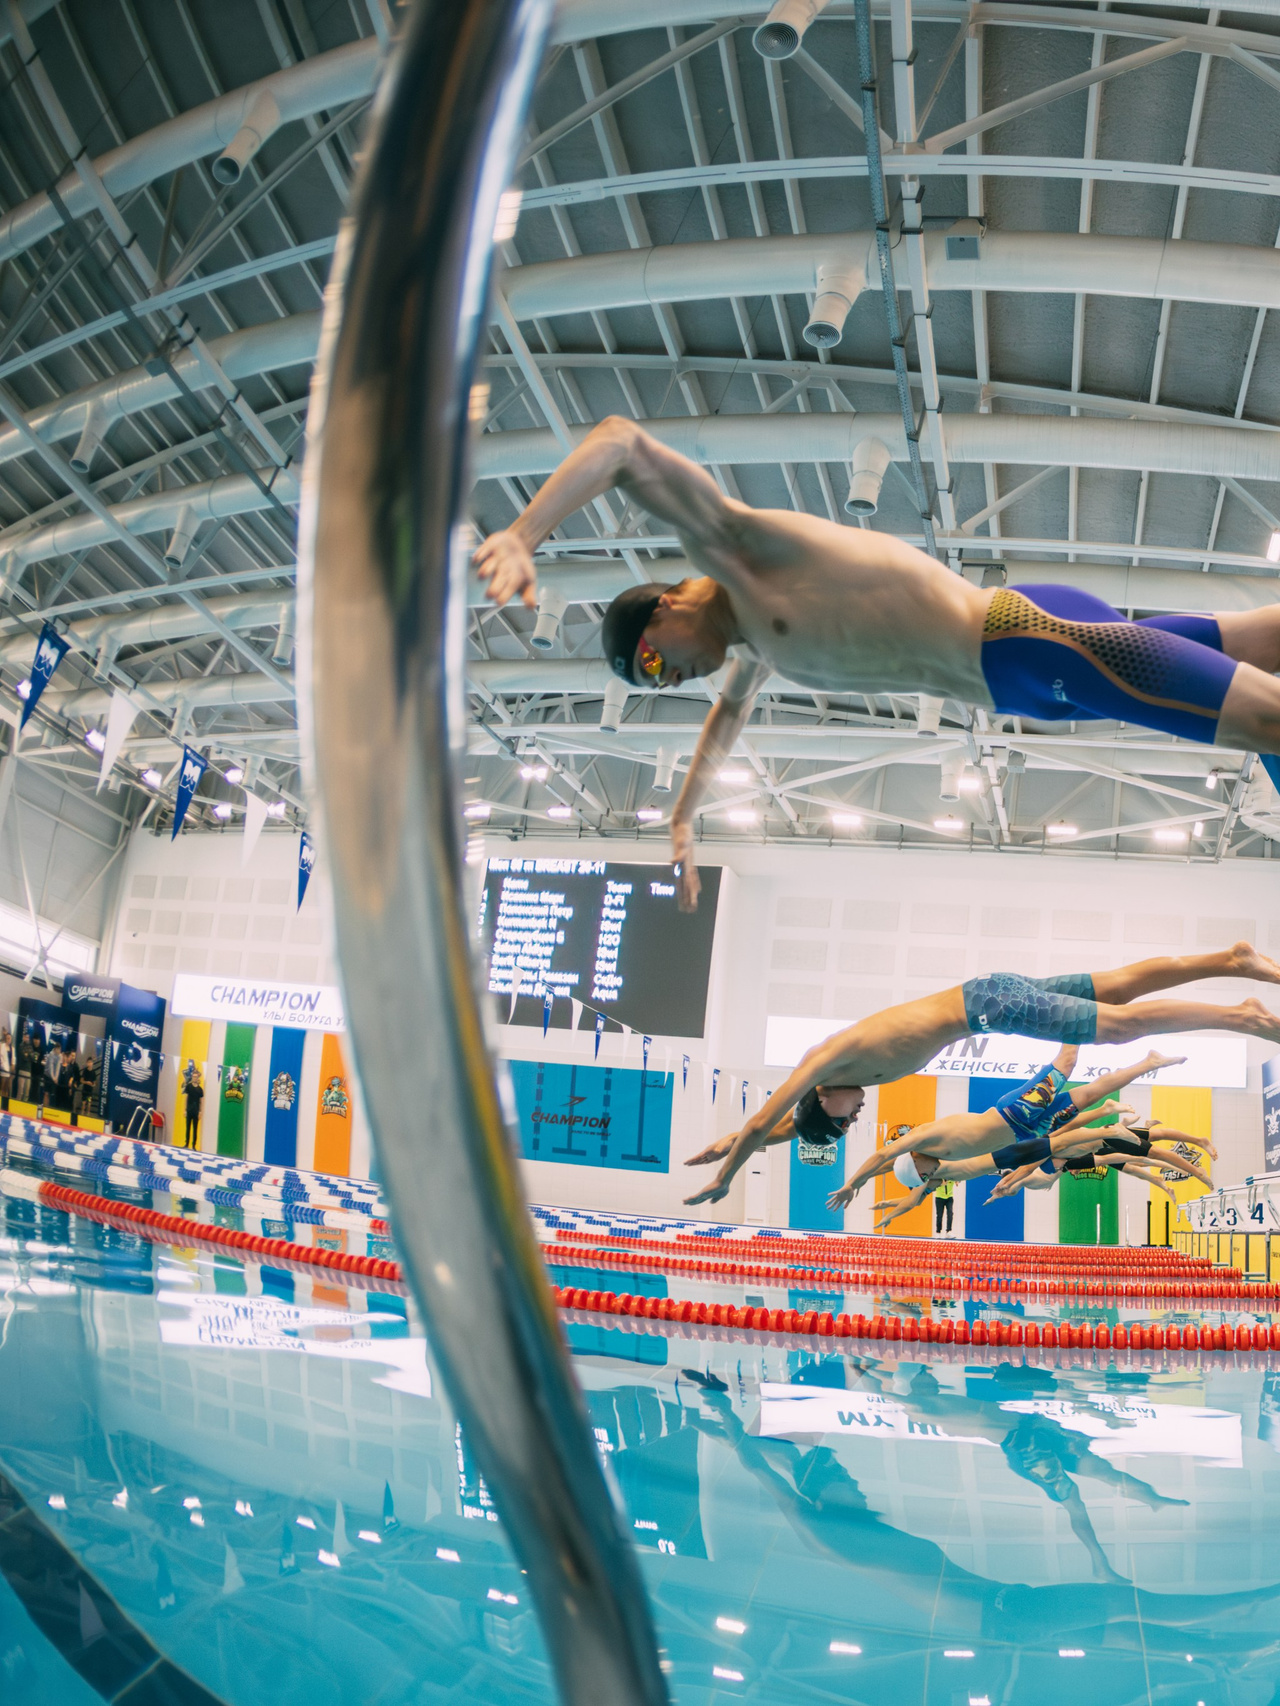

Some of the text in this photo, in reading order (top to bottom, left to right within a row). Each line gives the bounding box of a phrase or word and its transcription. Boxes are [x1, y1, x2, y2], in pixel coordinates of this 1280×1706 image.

[1210, 1212, 1218, 1227] 2
[1226, 1208, 1237, 1226] 3
[1250, 1203, 1264, 1224] 4
